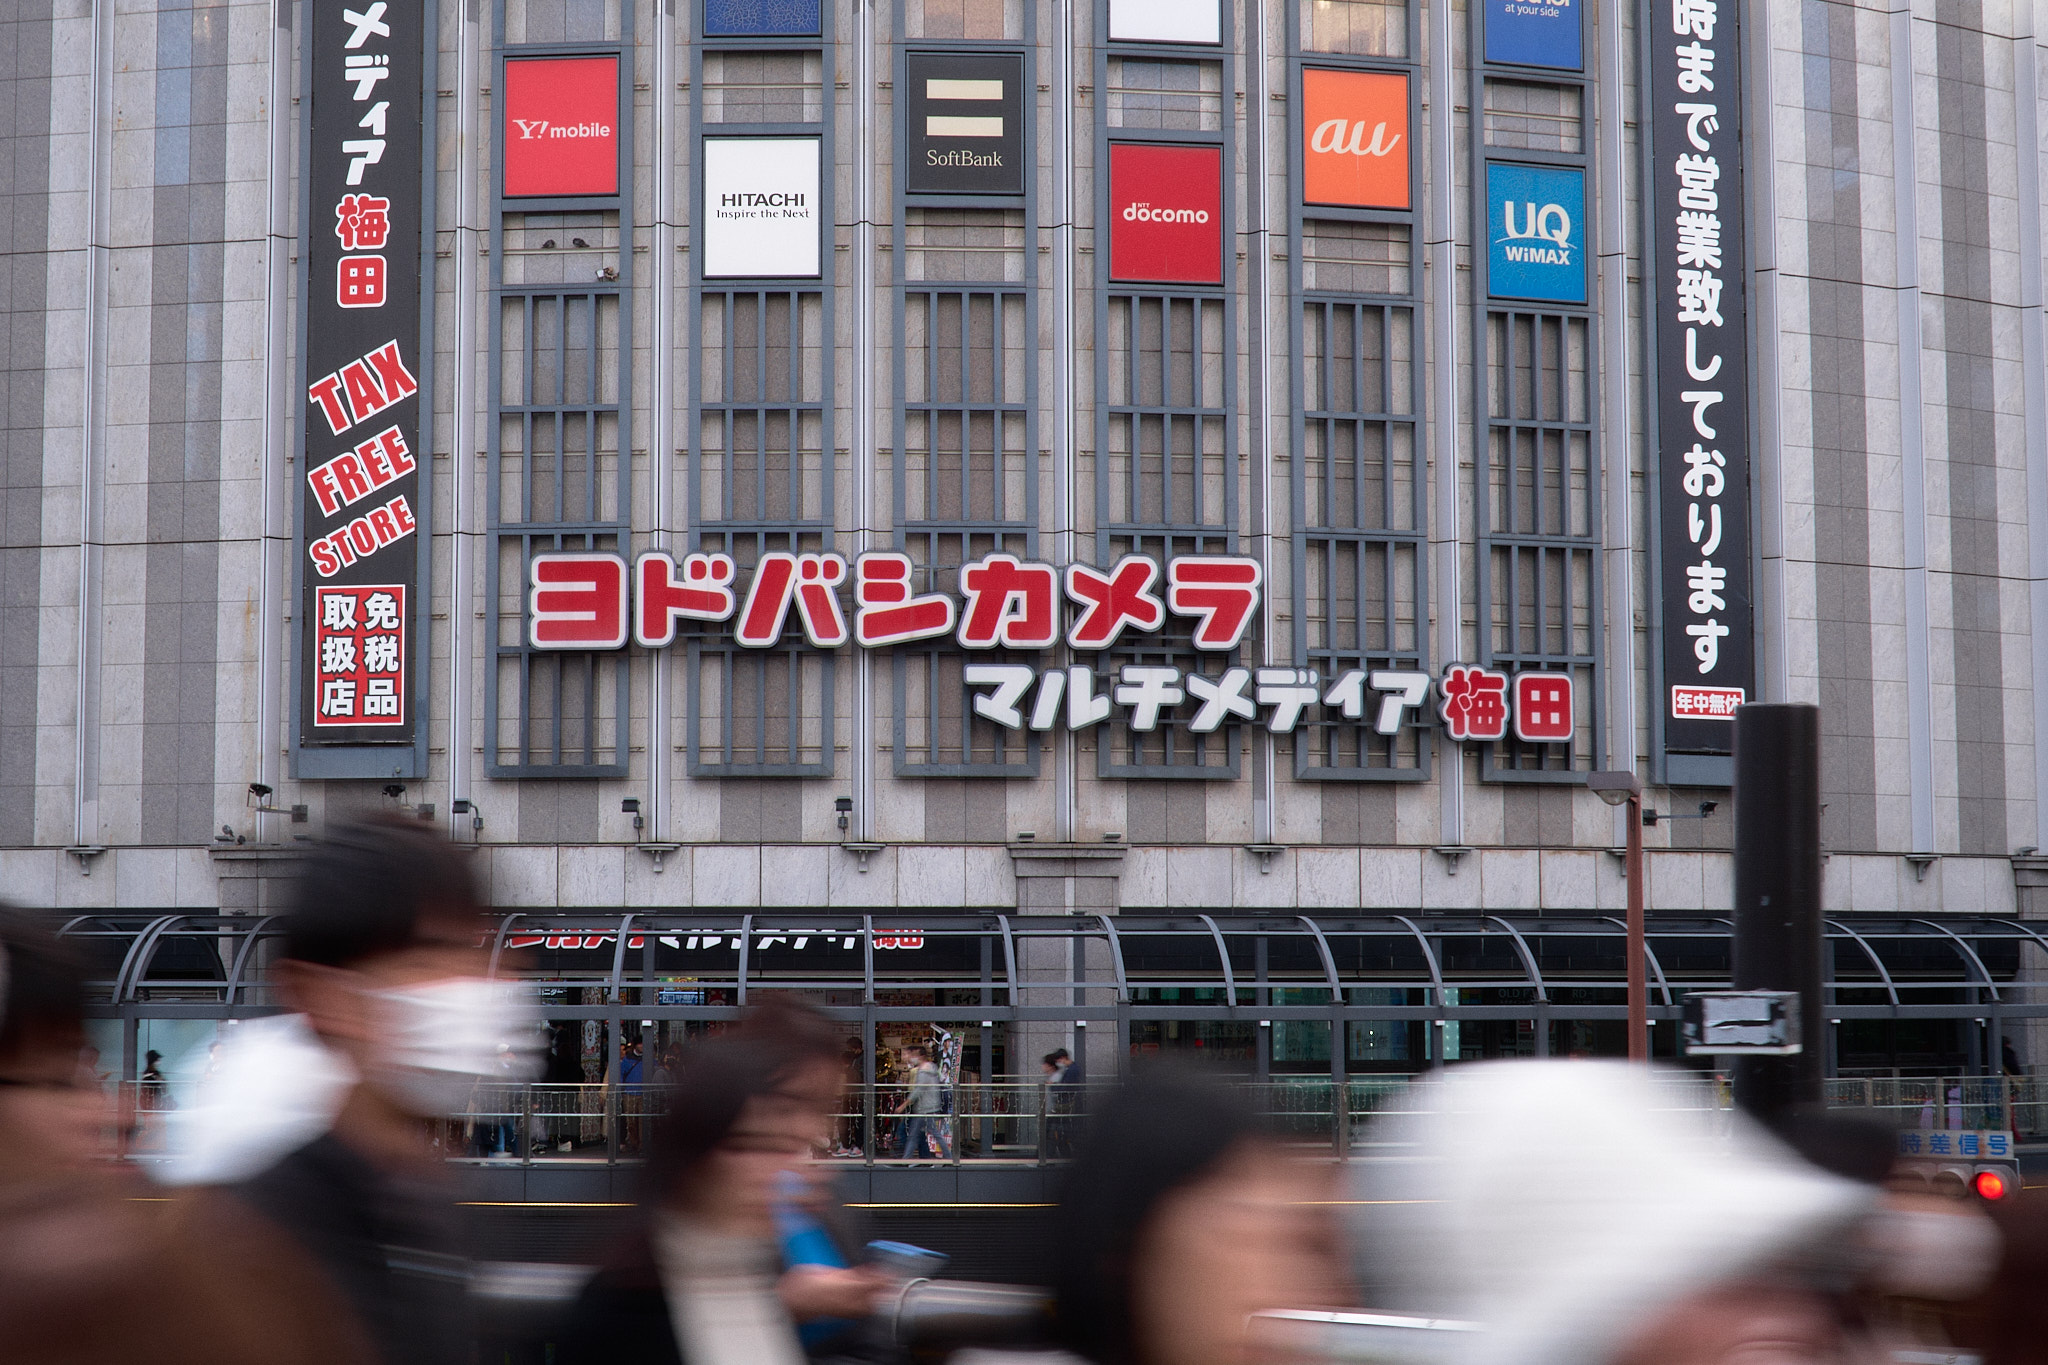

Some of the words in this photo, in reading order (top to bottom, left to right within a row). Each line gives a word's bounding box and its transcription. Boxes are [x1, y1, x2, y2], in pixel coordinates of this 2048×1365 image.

[1504, 3, 1515, 13] at
[1517, 5, 1539, 16] your
[1540, 6, 1560, 17] side
[512, 119, 610, 140] Y!mobile
[1311, 119, 1402, 157] au
[335, 2, 390, 308] メディア梅田
[926, 149, 1003, 167] SoftBank
[717, 209, 756, 220] Inspire
[760, 209, 779, 218] the
[782, 208, 809, 218] Next
[721, 193, 805, 206] HITACHI
[1123, 202, 1209, 224] docomo
[1504, 201, 1572, 248] UQ
[1505, 246, 1571, 265] WiMAX
[1672, 0, 1729, 673] 時まで営業致しております
[309, 339, 418, 436] TAX
[308, 424, 417, 518] FREE
[309, 494, 416, 578] STORE
[529, 552, 1262, 650] ヨドバシカメラ
[321, 593, 359, 717] 取扱店
[363, 592, 400, 717] 免税品
[964, 663, 1574, 743] マルチメディア梅田
[1676, 692, 1741, 715] 年中無休
[1899, 1133, 2009, 1155] 時差信号
